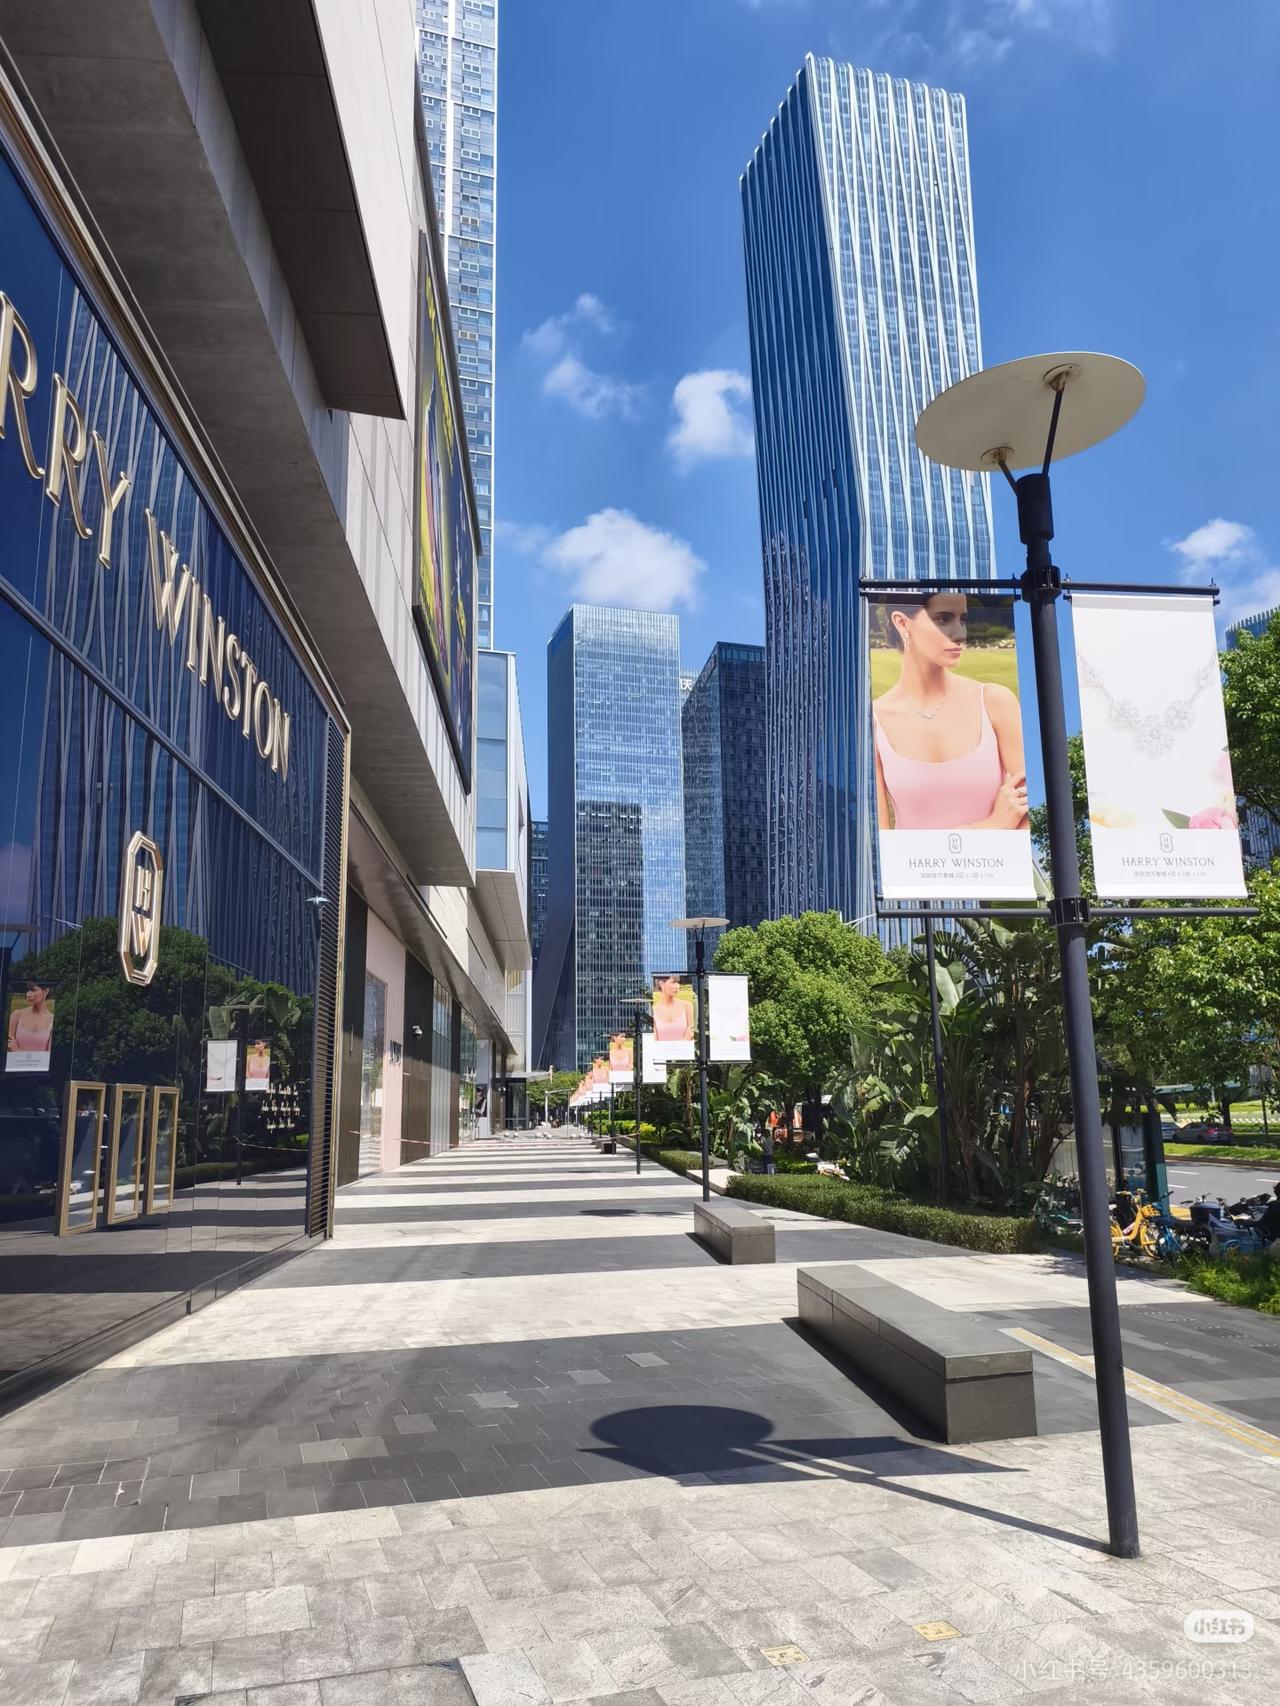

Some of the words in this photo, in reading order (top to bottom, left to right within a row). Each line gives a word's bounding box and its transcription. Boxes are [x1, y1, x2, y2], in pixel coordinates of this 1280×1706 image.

[145, 508, 290, 783] WINSTON
[908, 857, 947, 868] HARRY
[952, 857, 1004, 868] WINSTON
[1121, 856, 1159, 867] HARRY
[1163, 856, 1215, 867] WINSTON
